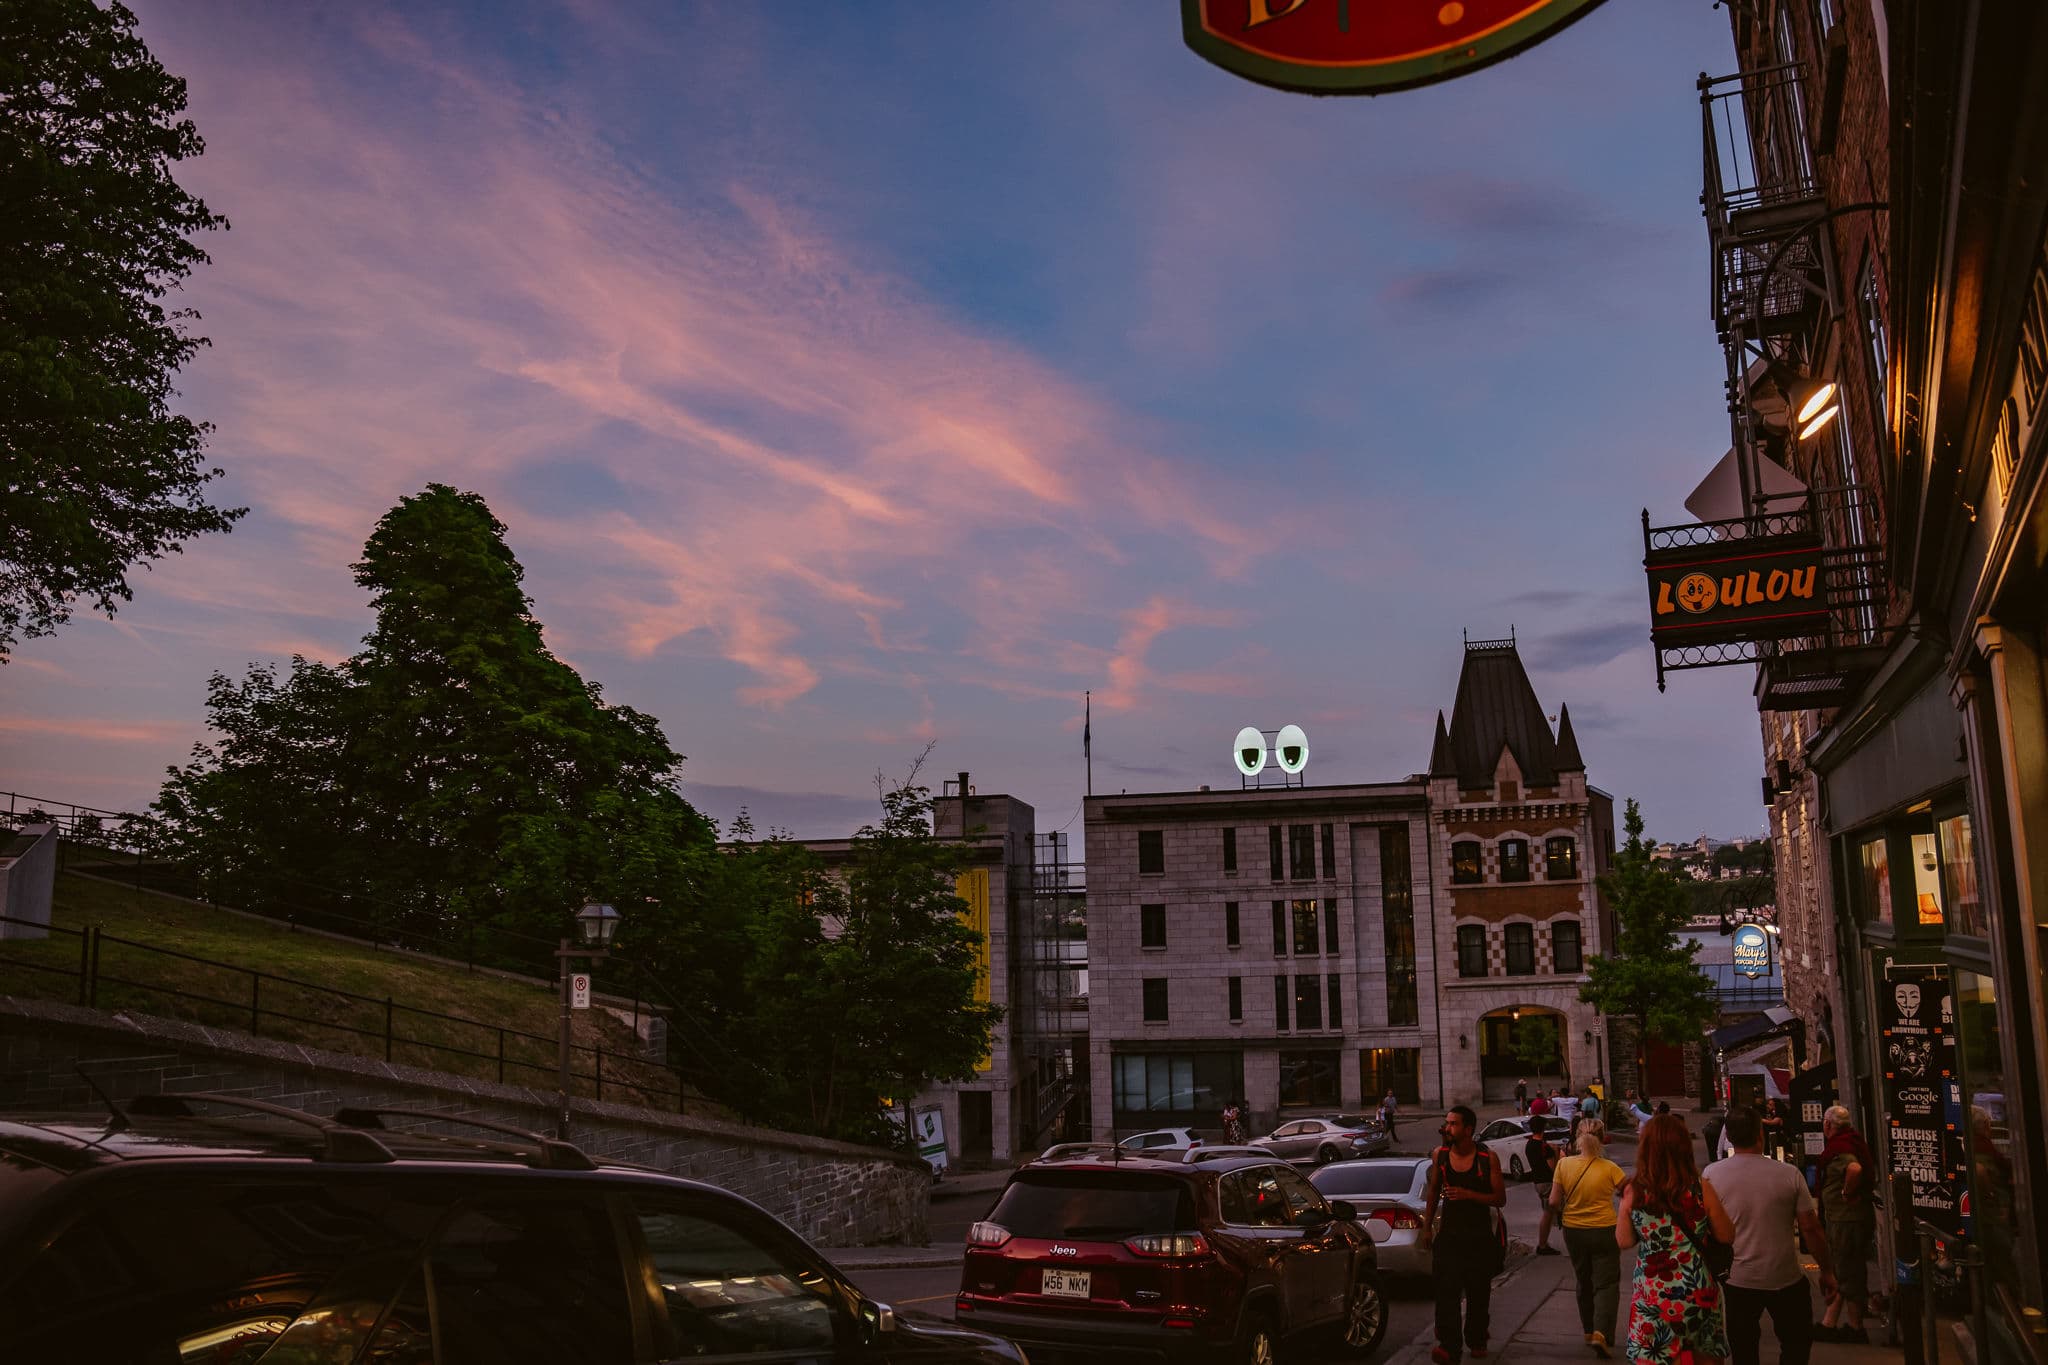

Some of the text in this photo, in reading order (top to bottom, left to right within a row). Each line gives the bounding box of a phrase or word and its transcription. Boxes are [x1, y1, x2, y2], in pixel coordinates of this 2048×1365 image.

[1655, 564, 1817, 616] LOULOU
[1898, 1090, 1939, 1105] Google
[1891, 1127, 1938, 1142] EXERCISE
[1913, 1184, 1925, 1194] he
[1050, 1244, 1077, 1256] Jeep
[1044, 1275, 1088, 1292] W56 NKM
